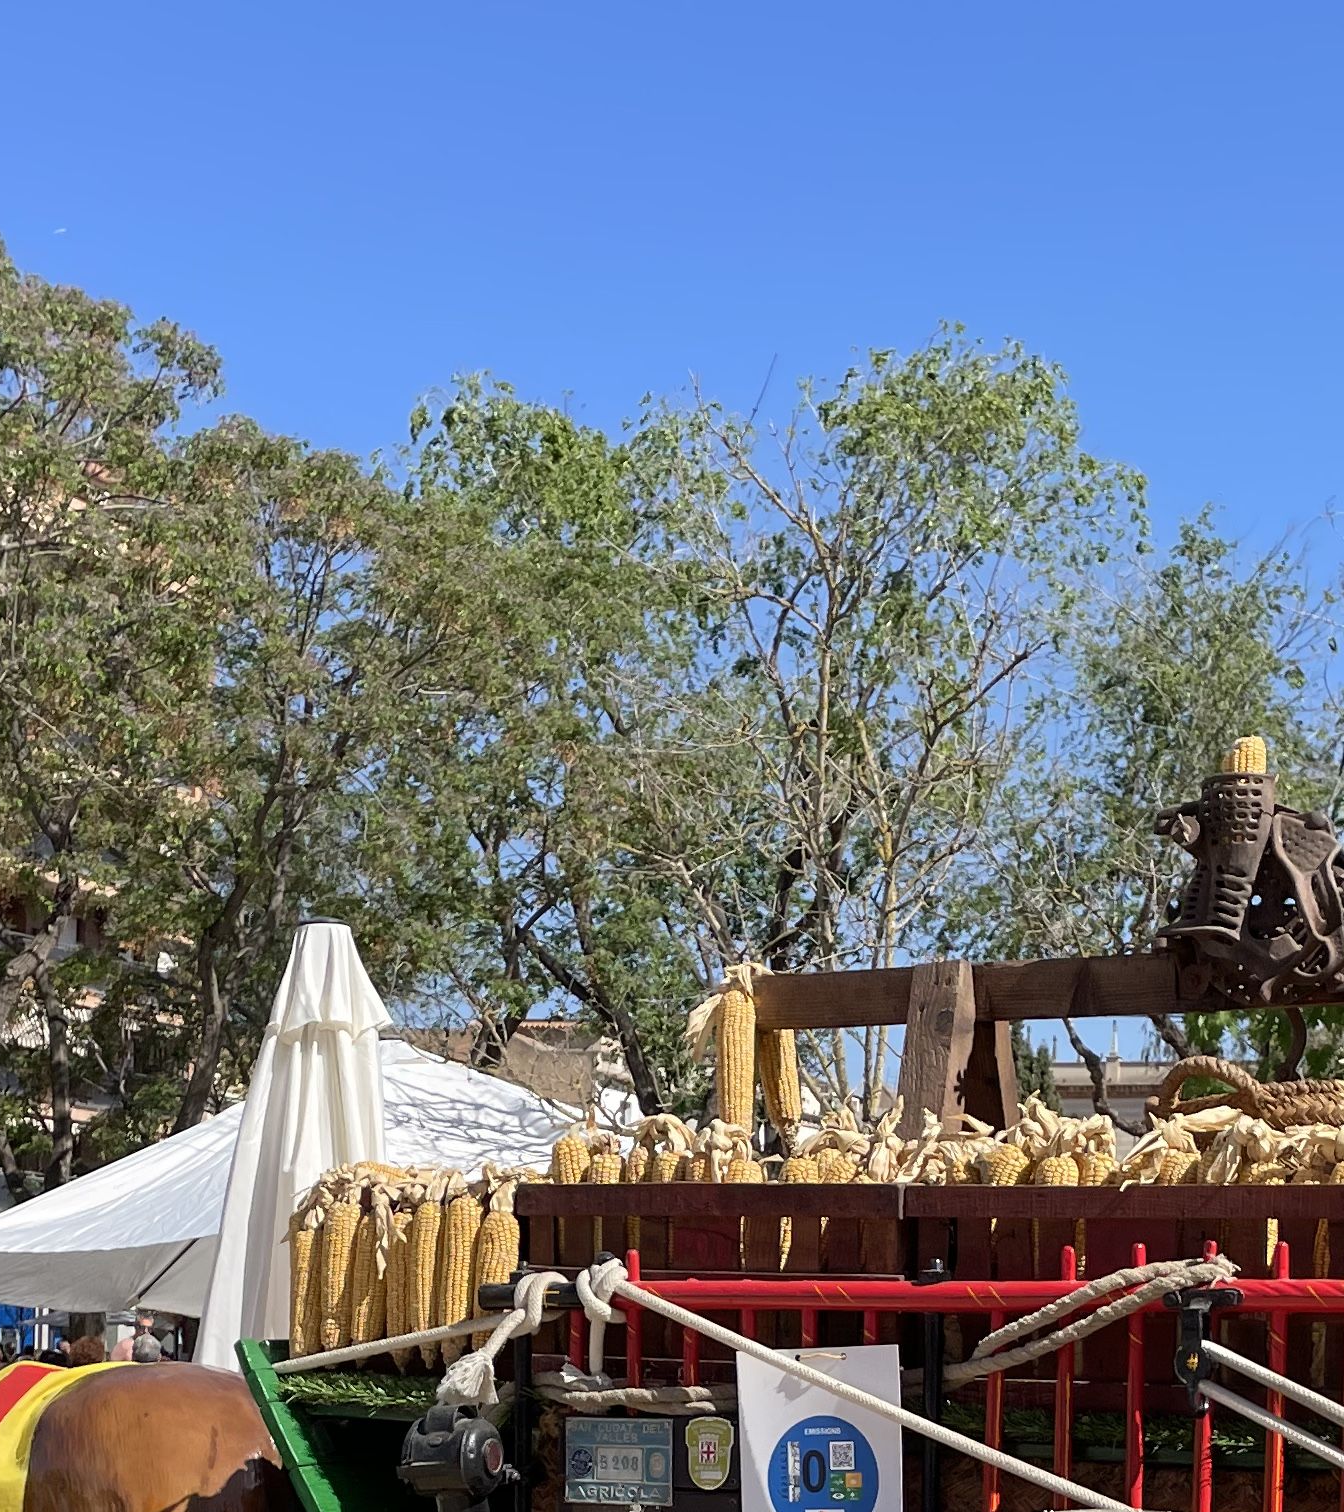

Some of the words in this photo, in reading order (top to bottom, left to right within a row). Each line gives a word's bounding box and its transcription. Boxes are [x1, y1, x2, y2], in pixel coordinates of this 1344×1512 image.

[572, 1423, 592, 1432] SAN
[597, 1423, 634, 1433] CUGAT
[642, 1424, 664, 1434] DEL
[595, 1433, 638, 1443] VALLES
[612, 1455, 639, 1471] 208
[802, 1450, 827, 1493] 0
[575, 1485, 661, 1500] AGRICOLA
